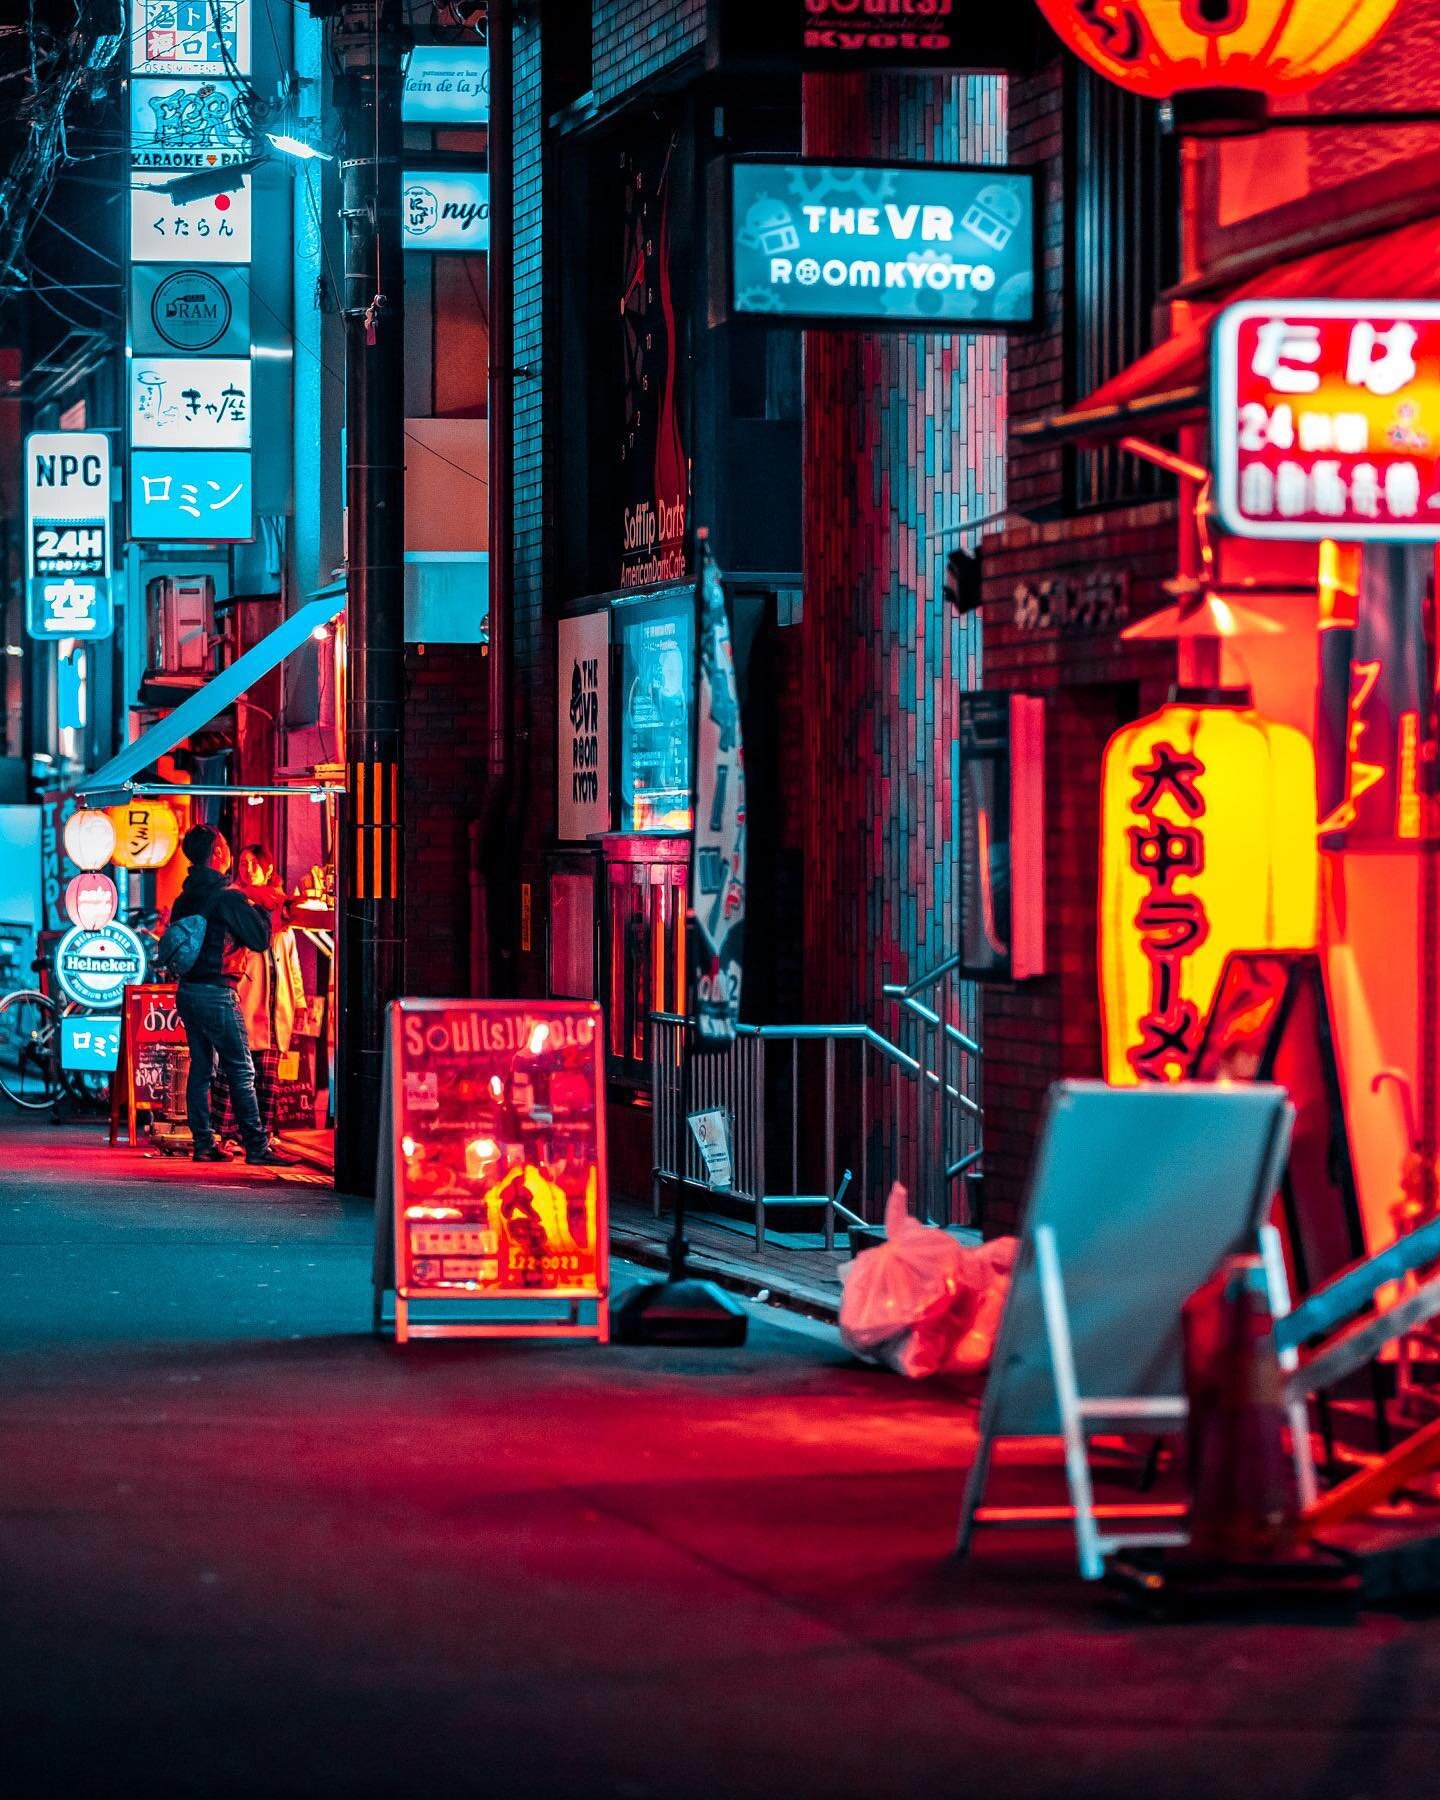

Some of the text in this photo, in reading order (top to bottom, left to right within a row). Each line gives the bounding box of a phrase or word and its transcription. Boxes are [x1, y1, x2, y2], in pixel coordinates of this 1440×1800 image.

[803, 29, 951, 49] Kyoto
[436, 78, 452, 92] de
[457, 79, 470, 92] la
[132, 153, 204, 167] KARAOKE
[153, 216, 234, 237] くたらん
[802, 203, 955, 242] THE VR
[769, 257, 996, 292] ROOM KYOTO
[165, 303, 218, 319] DRAM
[35, 454, 101, 487] NPC
[140, 475, 243, 517] ロミン
[658, 494, 685, 541] Darts
[36, 529, 103, 558] 24H
[582, 658, 598, 689] THE
[582, 691, 598, 733] VR
[572, 735, 598, 769] ROOM
[572, 770, 598, 804] KYOTO
[129, 810, 150, 856] ロミン
[67, 956, 135, 972] Heineken
